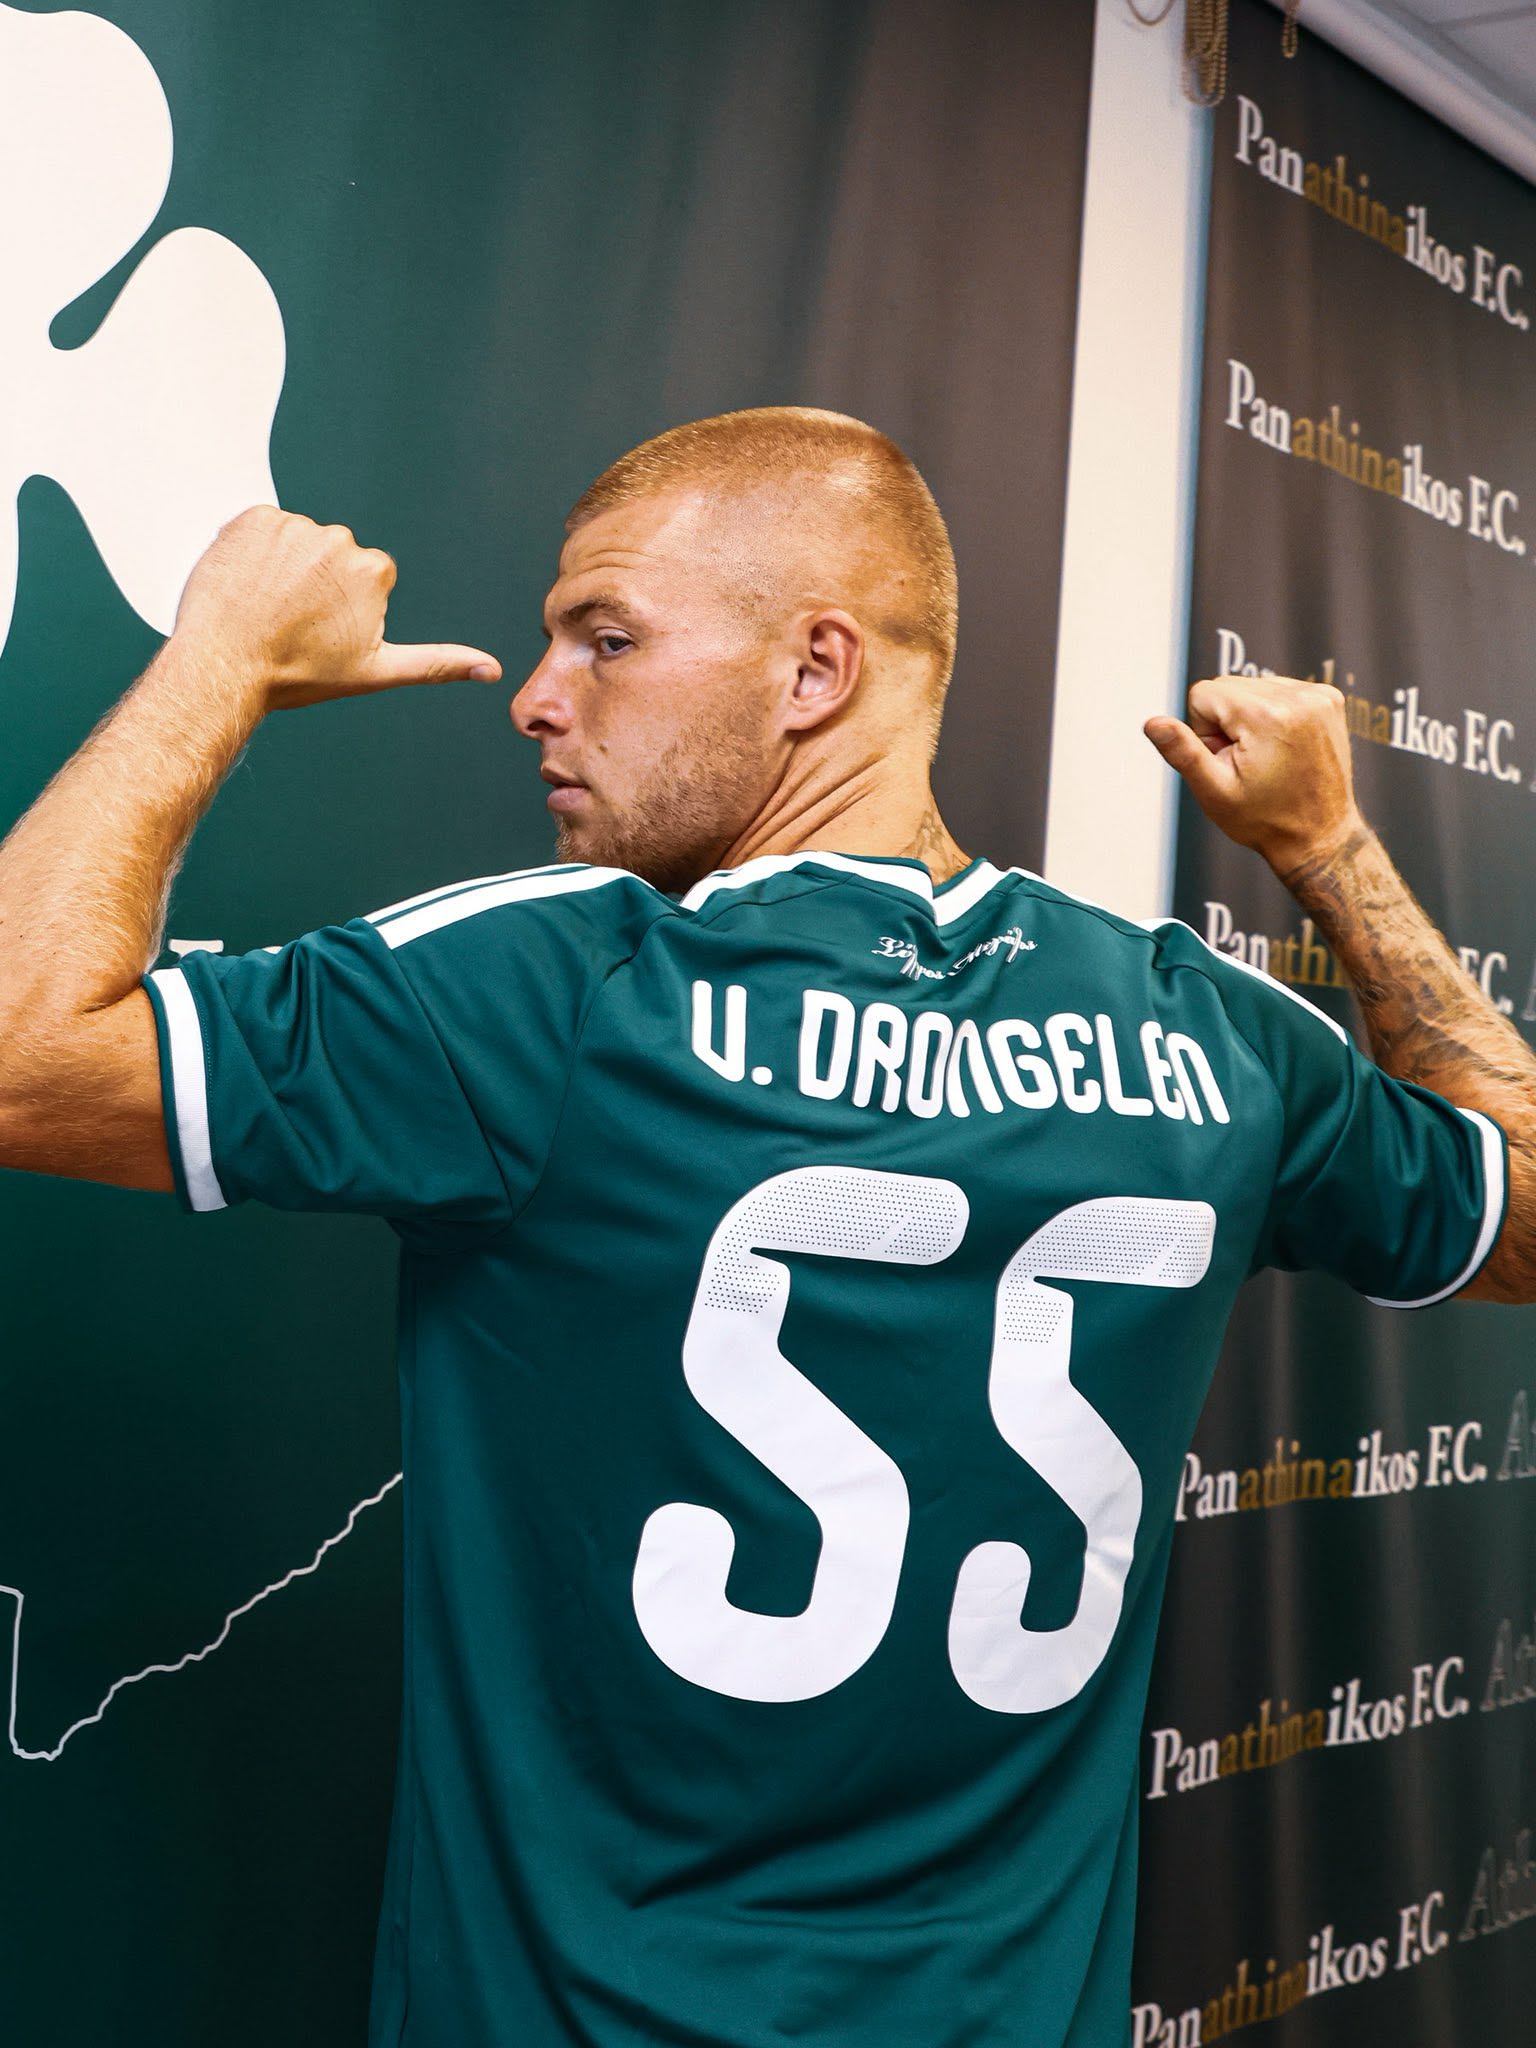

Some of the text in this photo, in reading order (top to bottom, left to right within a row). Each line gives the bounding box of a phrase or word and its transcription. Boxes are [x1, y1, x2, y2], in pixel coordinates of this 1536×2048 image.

[1234, 94, 1530, 331] Panathinaikos F.C.
[1224, 358, 1527, 555] Panathinaikos F.C.
[1462, 708, 1522, 784] F.C.
[632, 1164, 1217, 1714] 55
[1174, 1422, 1489, 1523] Panathinaikos F.C.
[1146, 1656, 1470, 1800] Panathinaikos F.C.
[1131, 1891, 1450, 2048] Panathinaikos F.C.
